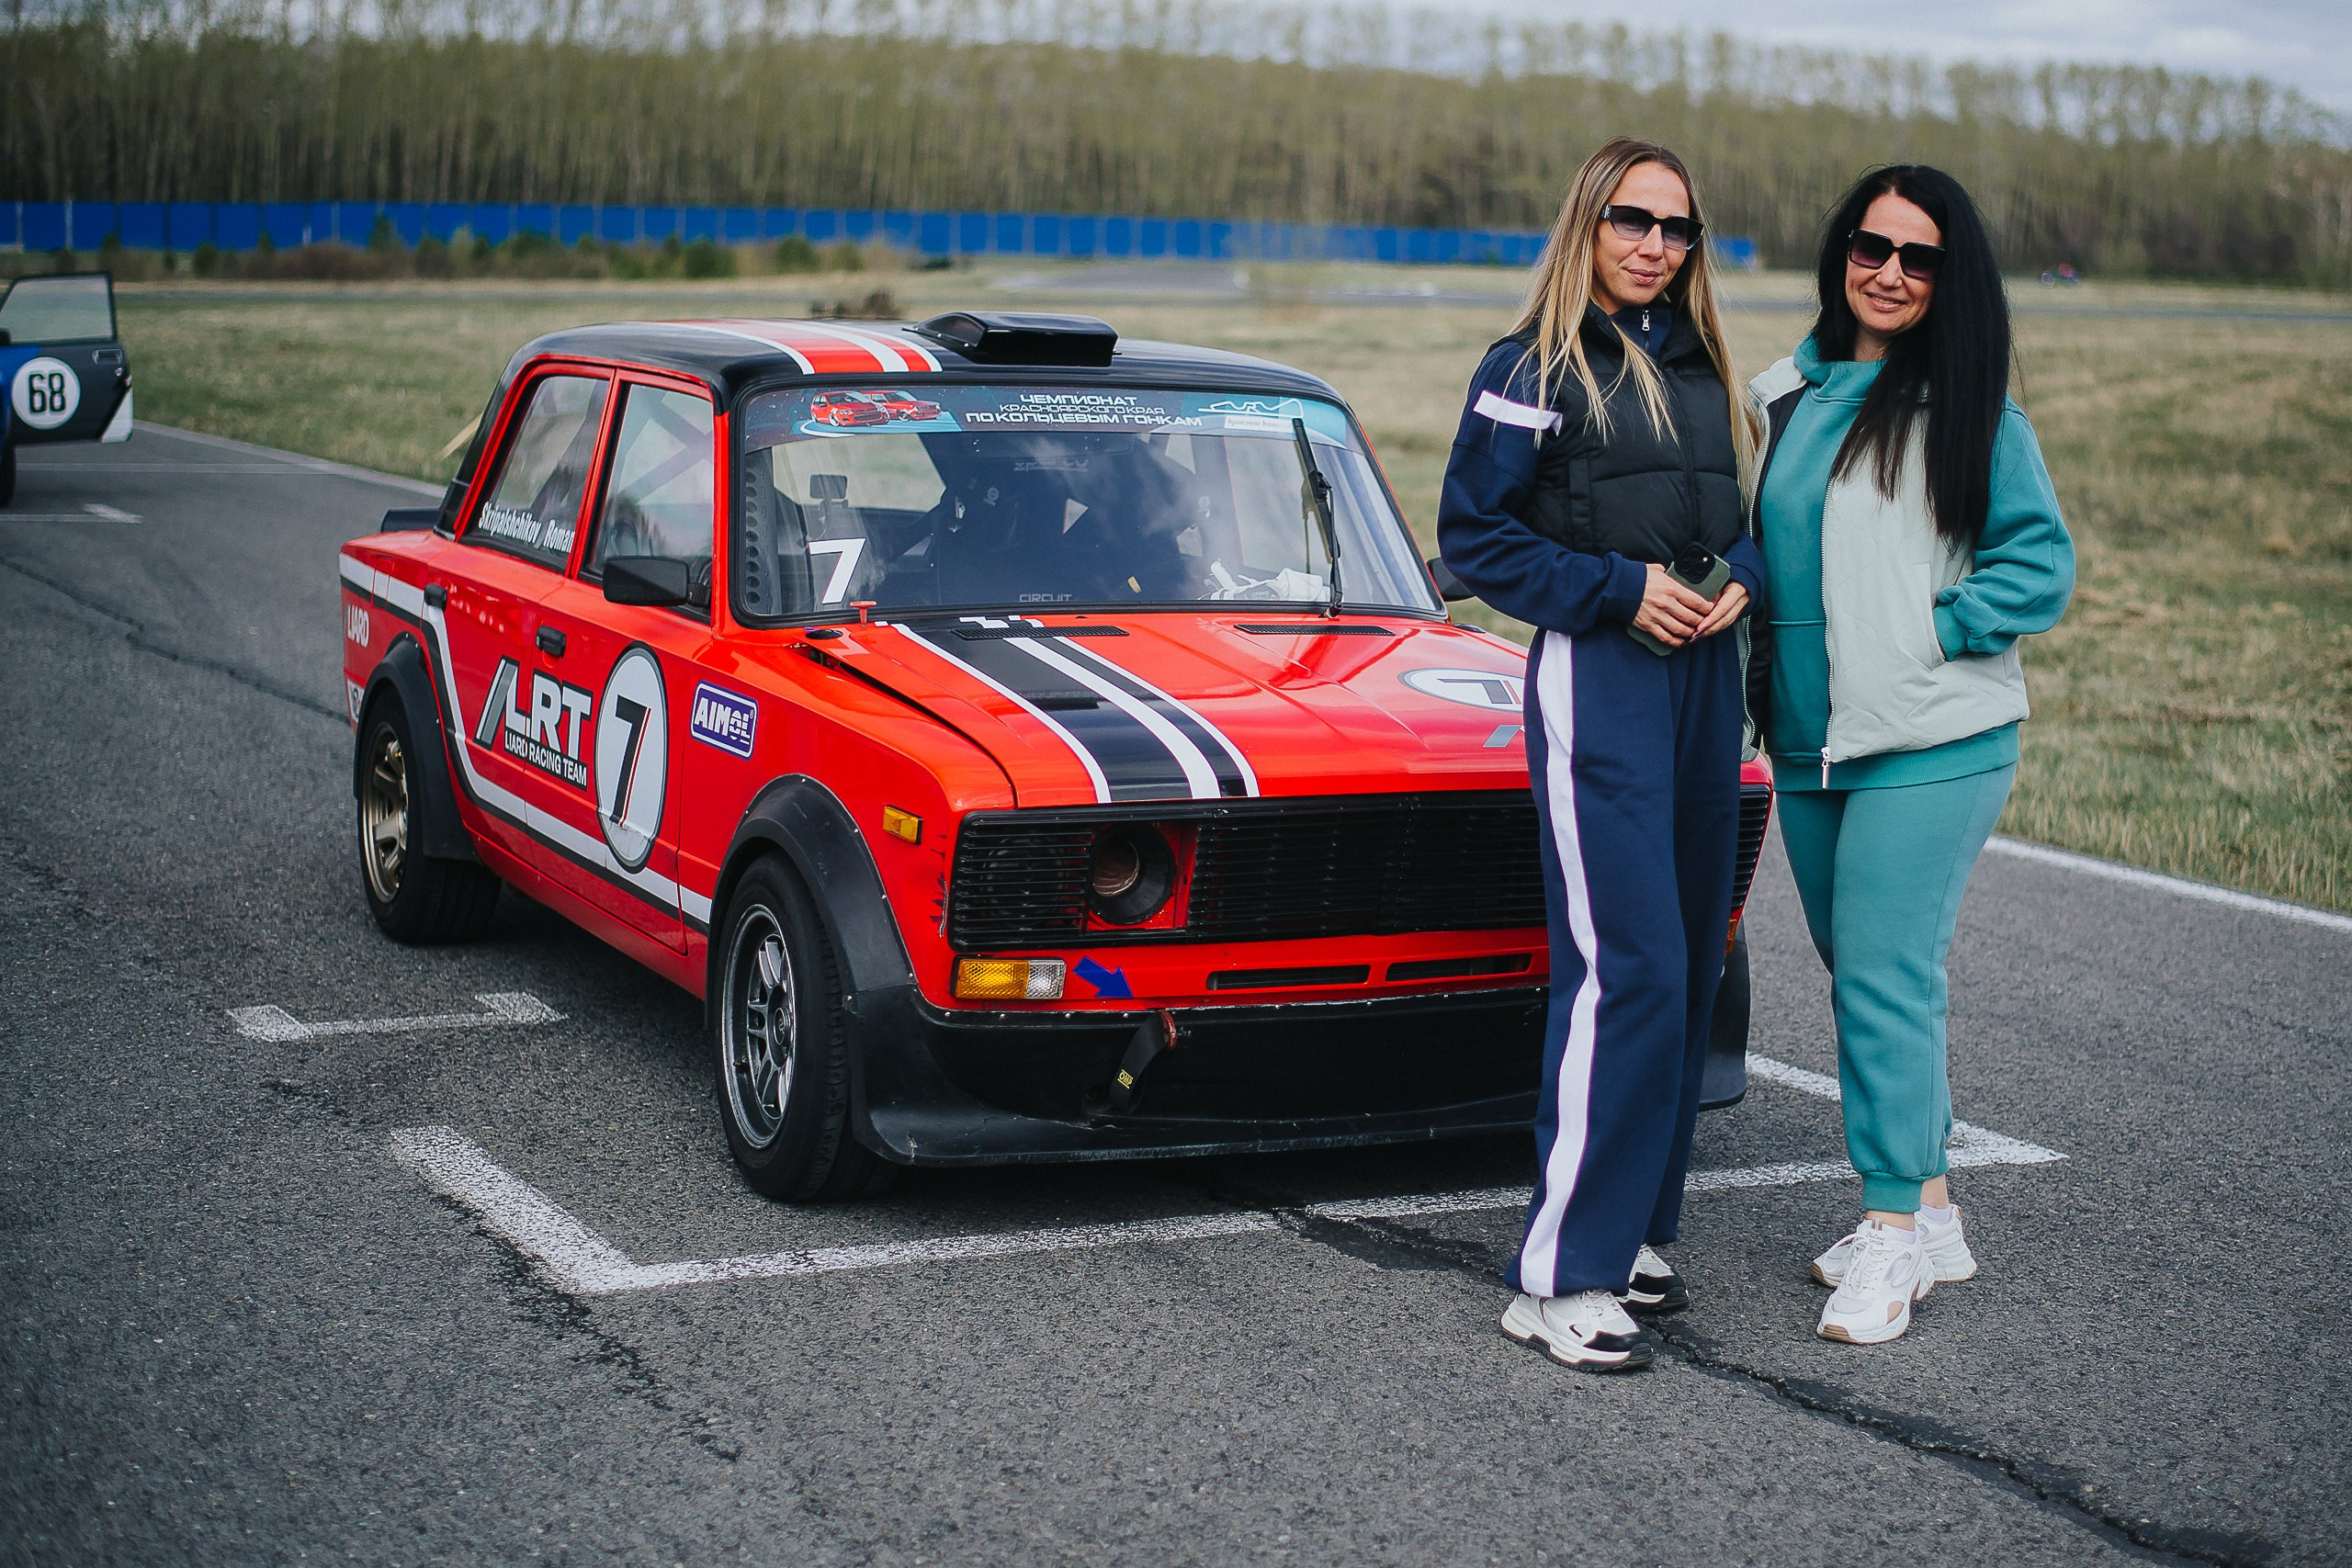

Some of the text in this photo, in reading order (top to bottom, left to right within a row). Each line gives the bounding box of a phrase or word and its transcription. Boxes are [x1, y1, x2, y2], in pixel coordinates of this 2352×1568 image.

[28, 372, 66, 413] 68
[999, 404, 1165, 415] КРАСНОЯРСКОГО КРАЯ
[1020, 394, 1137, 406] ЧЕМПИОНАТ
[965, 412, 1203, 426] ПО КОЛЬЦЕВЫМ ГОНКАМ
[479, 501, 575, 553] Skripalshchikov Roman
[808, 538, 866, 605] 7
[1019, 593, 1073, 603] CIRCUIT
[347, 604, 369, 649] LIARD
[505, 729, 587, 786] LIARD RACING TEAM
[610, 694, 650, 826] 7
